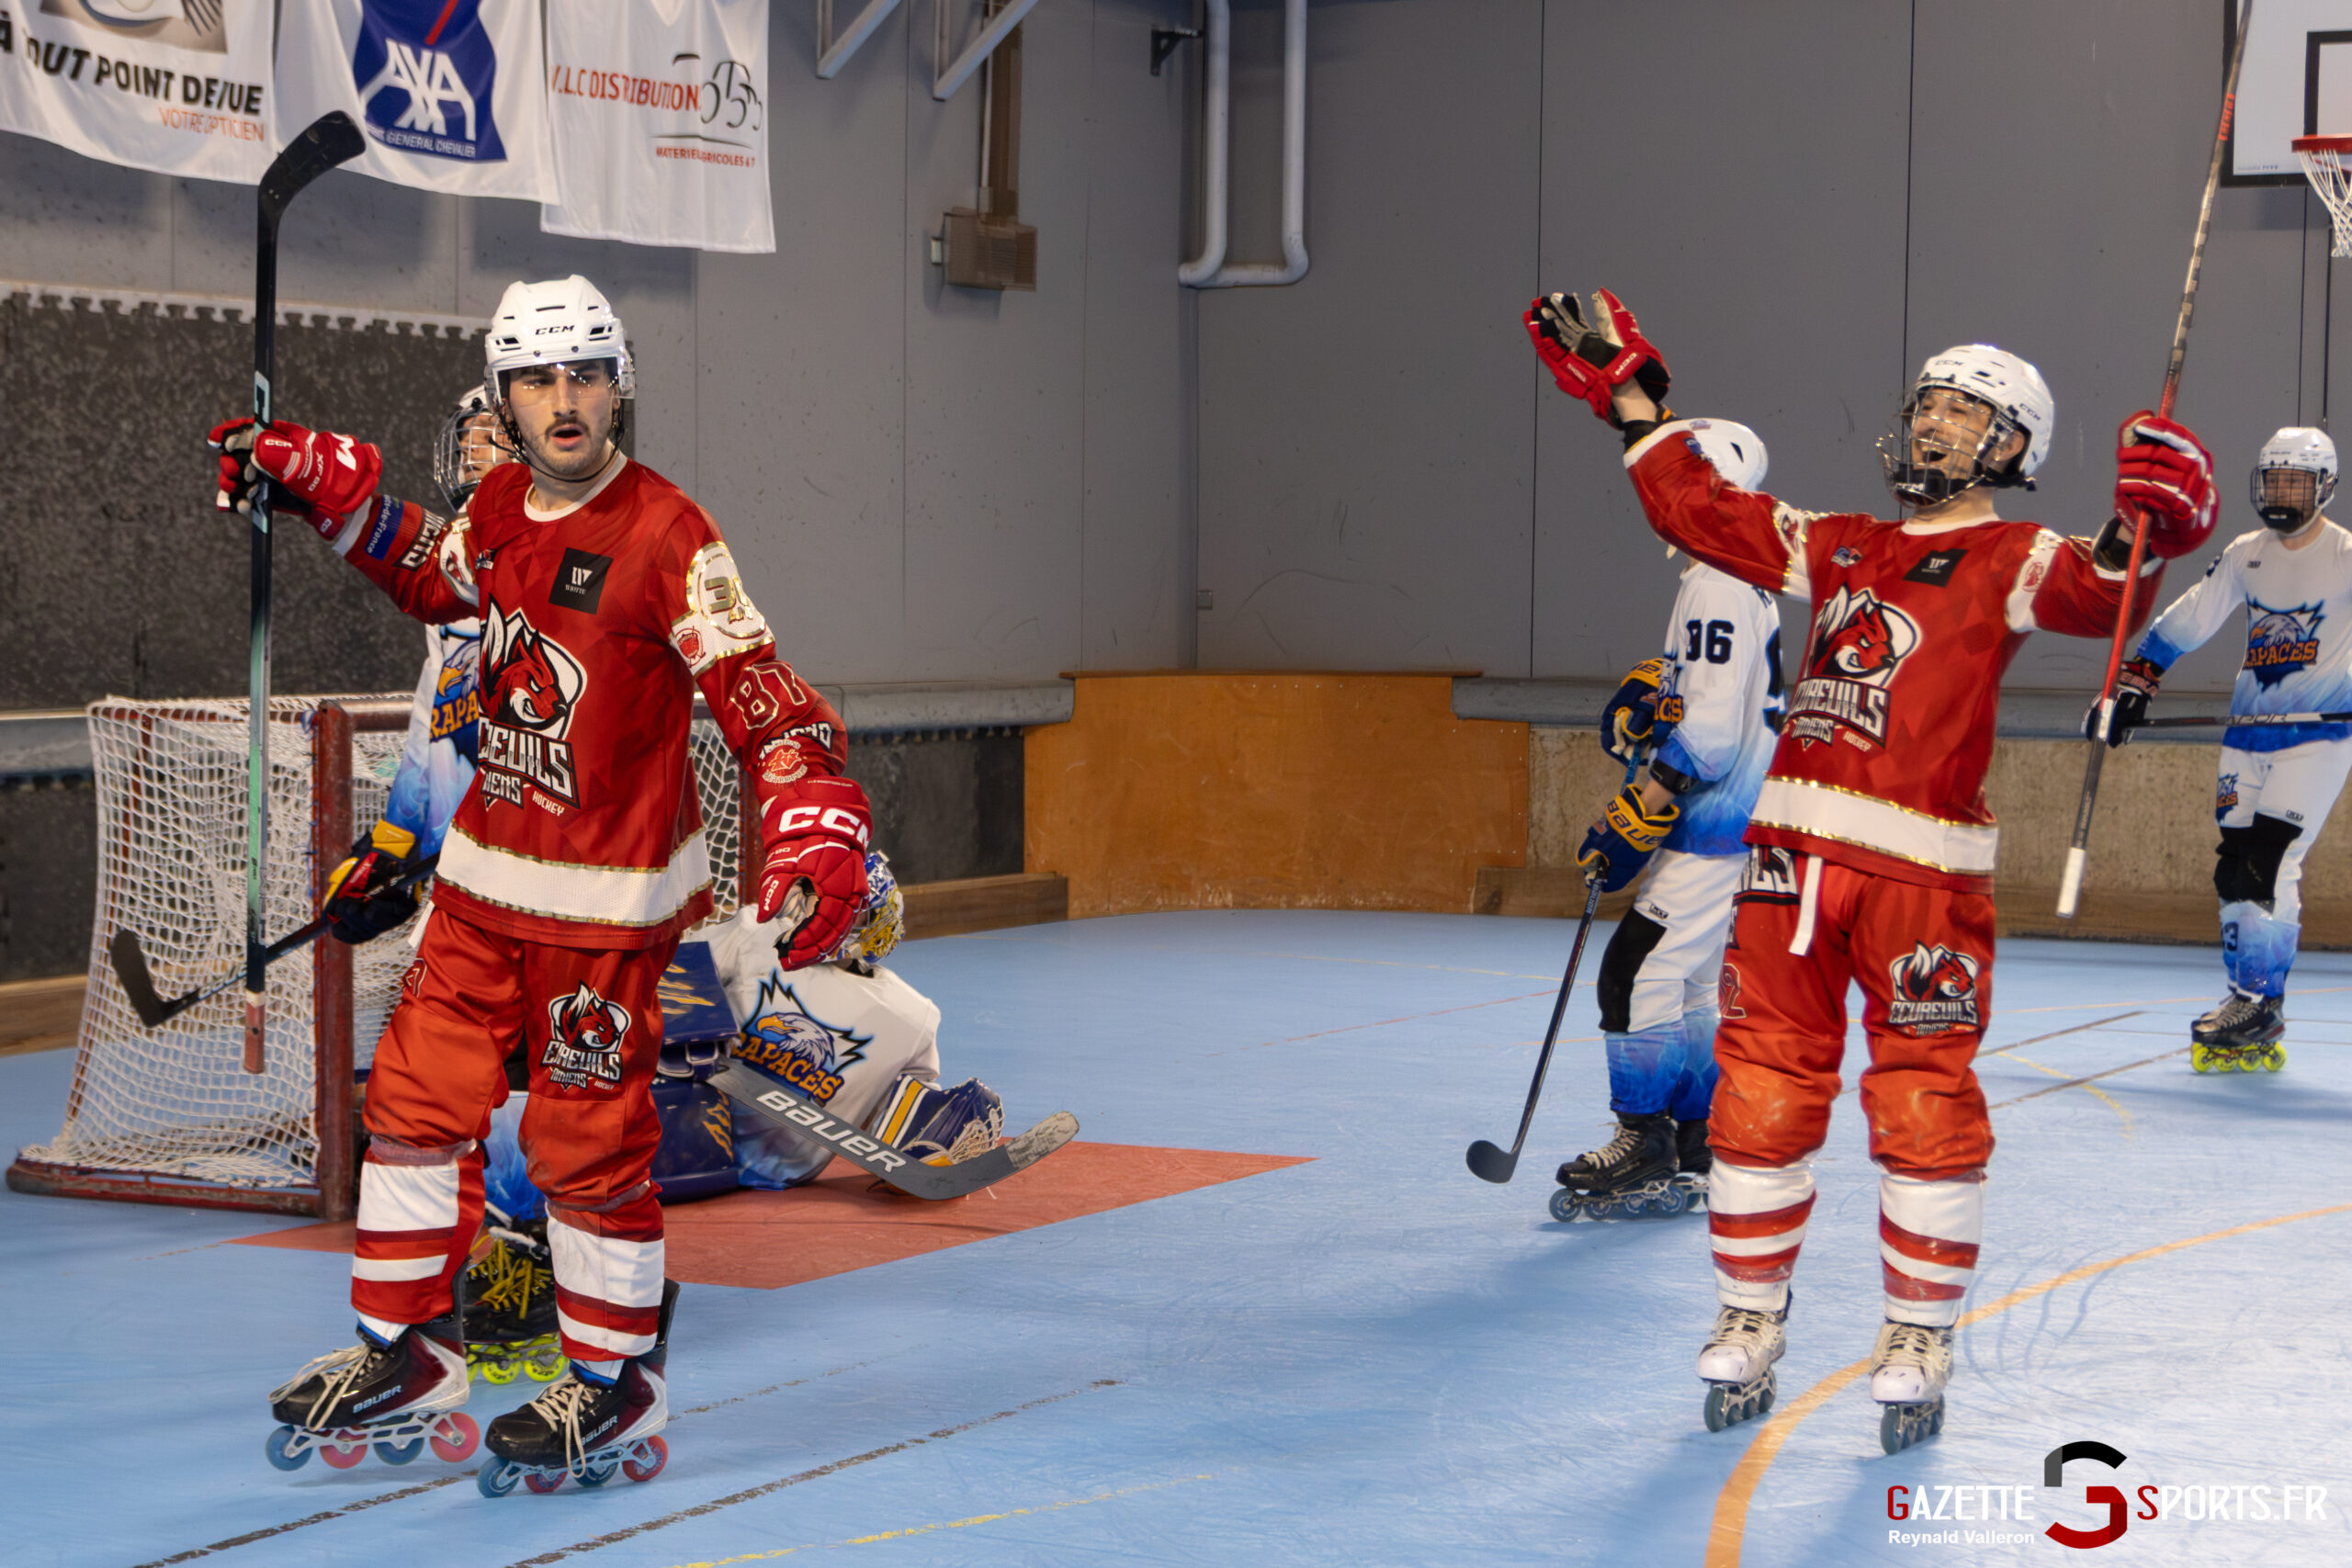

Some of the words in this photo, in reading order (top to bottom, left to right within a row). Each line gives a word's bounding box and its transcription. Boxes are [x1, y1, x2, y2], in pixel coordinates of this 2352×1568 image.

[26, 37, 90, 81] OUT
[95, 55, 174, 101] POINT
[183, 74, 218, 107] DE
[359, 36, 477, 141] AXA
[158, 107, 203, 134] VOTRE
[204, 116, 265, 141] OPTICIEN
[535, 324, 575, 335] CCM
[2018, 402, 2041, 422] CCM
[265, 438, 293, 449] CCM
[2245, 639, 2317, 668] APACES
[729, 661, 808, 731] 87
[429, 690, 480, 740] RAPA
[532, 790, 566, 817] HOCKEY
[763, 878, 780, 912] CCM
[1889, 999, 1978, 1025] ECUREUILS
[756, 1090, 907, 1173] BAUER
[353, 1384, 401, 1414] BAUER
